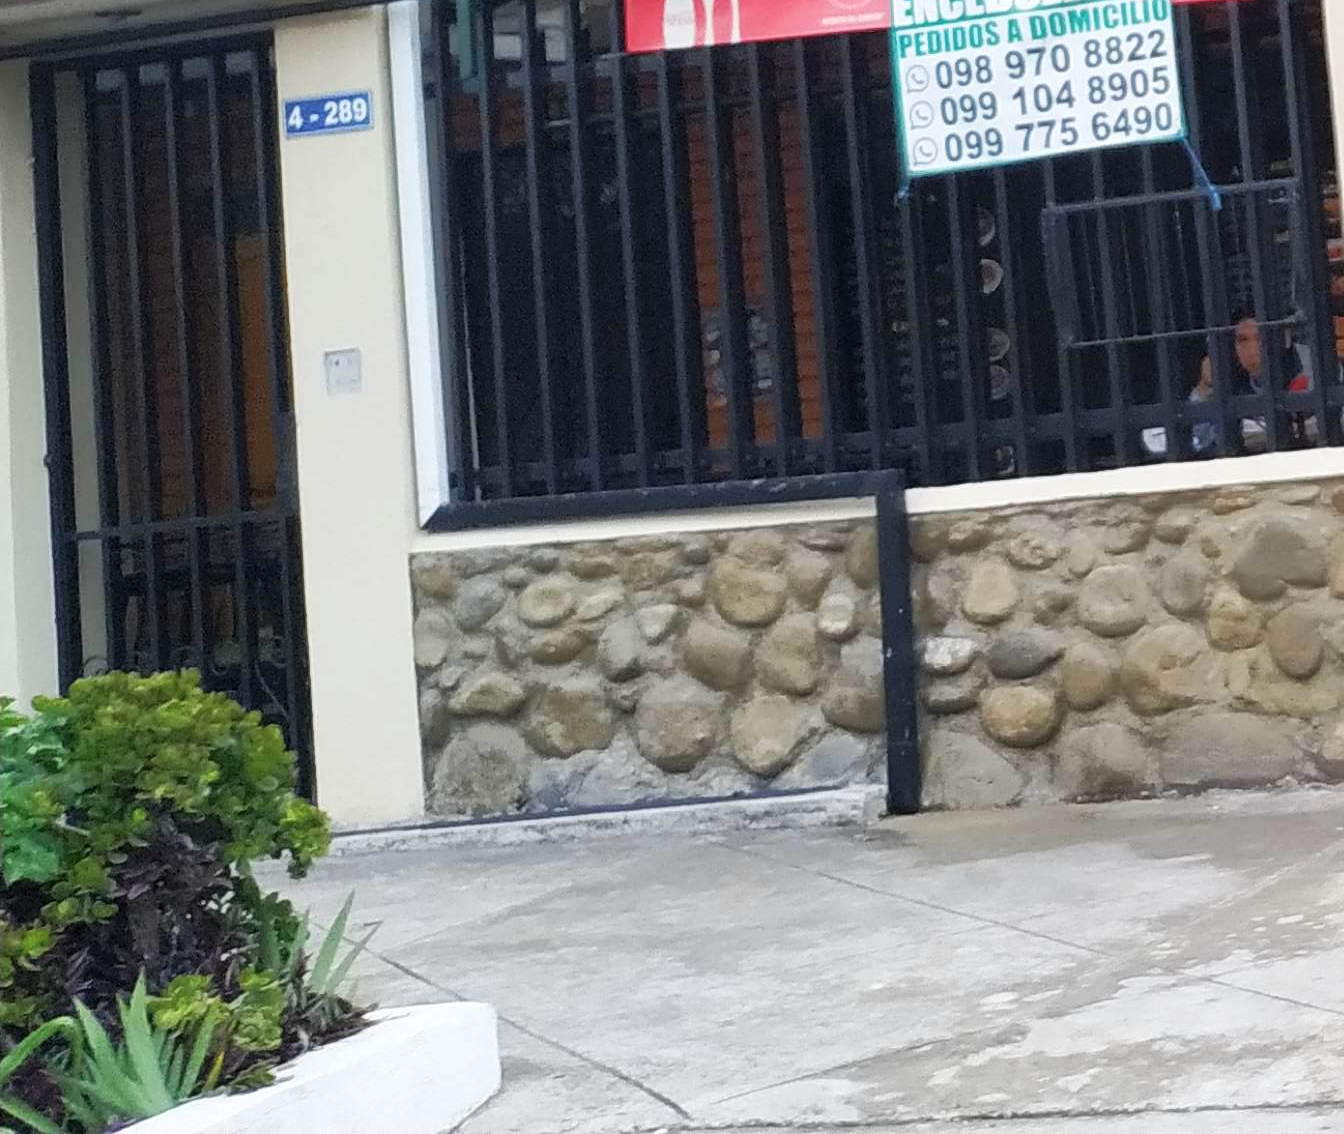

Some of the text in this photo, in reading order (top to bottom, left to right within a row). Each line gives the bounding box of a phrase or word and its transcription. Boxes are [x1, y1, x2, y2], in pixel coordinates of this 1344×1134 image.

[900, 21, 1001, 58] PEDIDOS
[1007, 18, 1024, 43] A
[935, 28, 1167, 90] 098 970 8822
[940, 65, 1171, 126] 099 104 8905
[944, 102, 1173, 162] 099 775 6490
